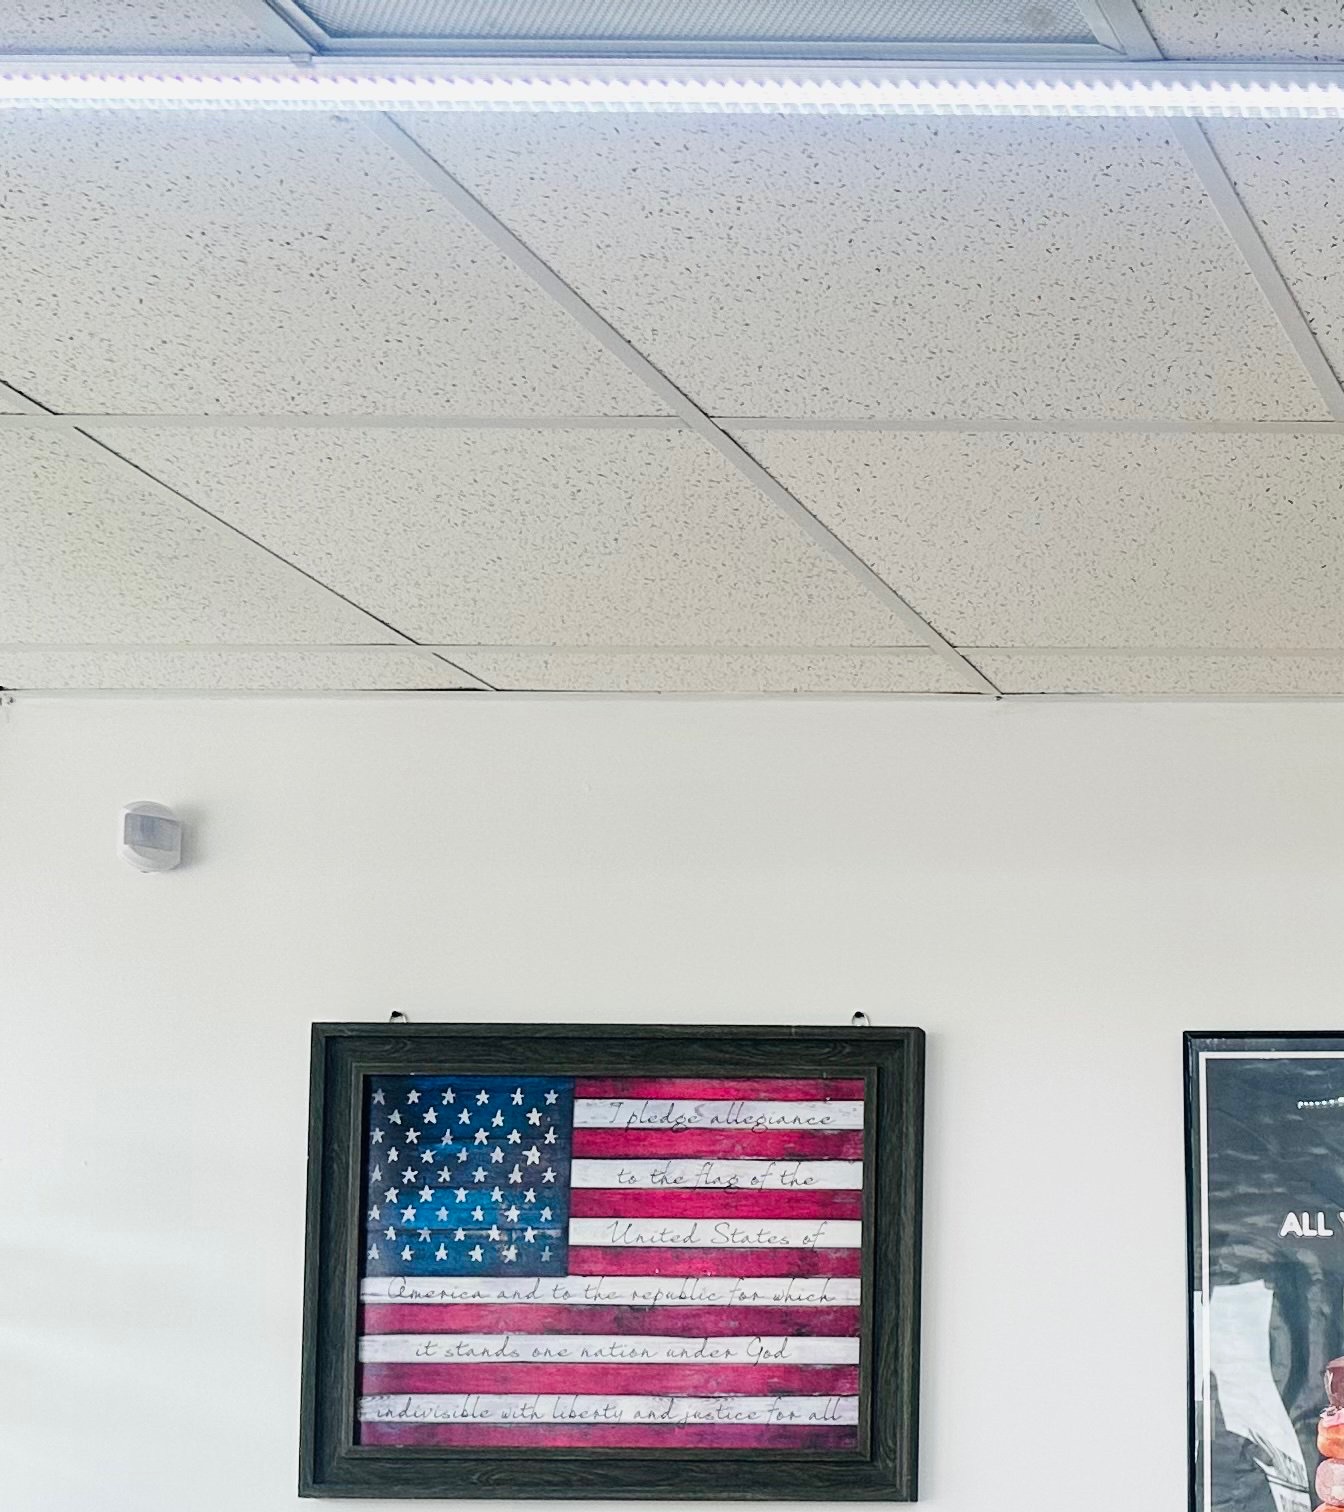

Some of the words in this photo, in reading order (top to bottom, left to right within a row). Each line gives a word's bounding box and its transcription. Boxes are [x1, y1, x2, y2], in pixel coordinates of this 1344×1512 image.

[608, 1101, 623, 1123] I
[625, 1101, 699, 1132] pledge
[710, 1102, 837, 1133] allegiance
[618, 1168, 637, 1185] to
[650, 1161, 688, 1185] the
[692, 1162, 740, 1193] flag
[750, 1162, 777, 1192] of
[780, 1161, 818, 1186] the
[607, 1220, 700, 1245] United
[710, 1222, 790, 1245] States
[802, 1221, 828, 1251] of
[1279, 1211, 1334, 1238] ALL
[387, 1275, 489, 1299] America
[496, 1277, 545, 1300] and
[552, 1283, 575, 1300] to
[584, 1276, 622, 1301] the
[632, 1277, 722, 1308] republic
[728, 1277, 765, 1308] for
[772, 1277, 836, 1303] which
[415, 1341, 438, 1357] it
[444, 1336, 521, 1358] stands
[531, 1348, 573, 1358] one
[580, 1341, 658, 1359] nation
[666, 1337, 738, 1360] under
[746, 1337, 792, 1366] God
[376, 1394, 494, 1420] indivisible
[500, 1395, 545, 1419] with
[552, 1395, 623, 1422] liberty
[633, 1398, 677, 1420] and
[678, 1402, 762, 1429] justice
[766, 1396, 802, 1425] for
[808, 1398, 843, 1421] all
